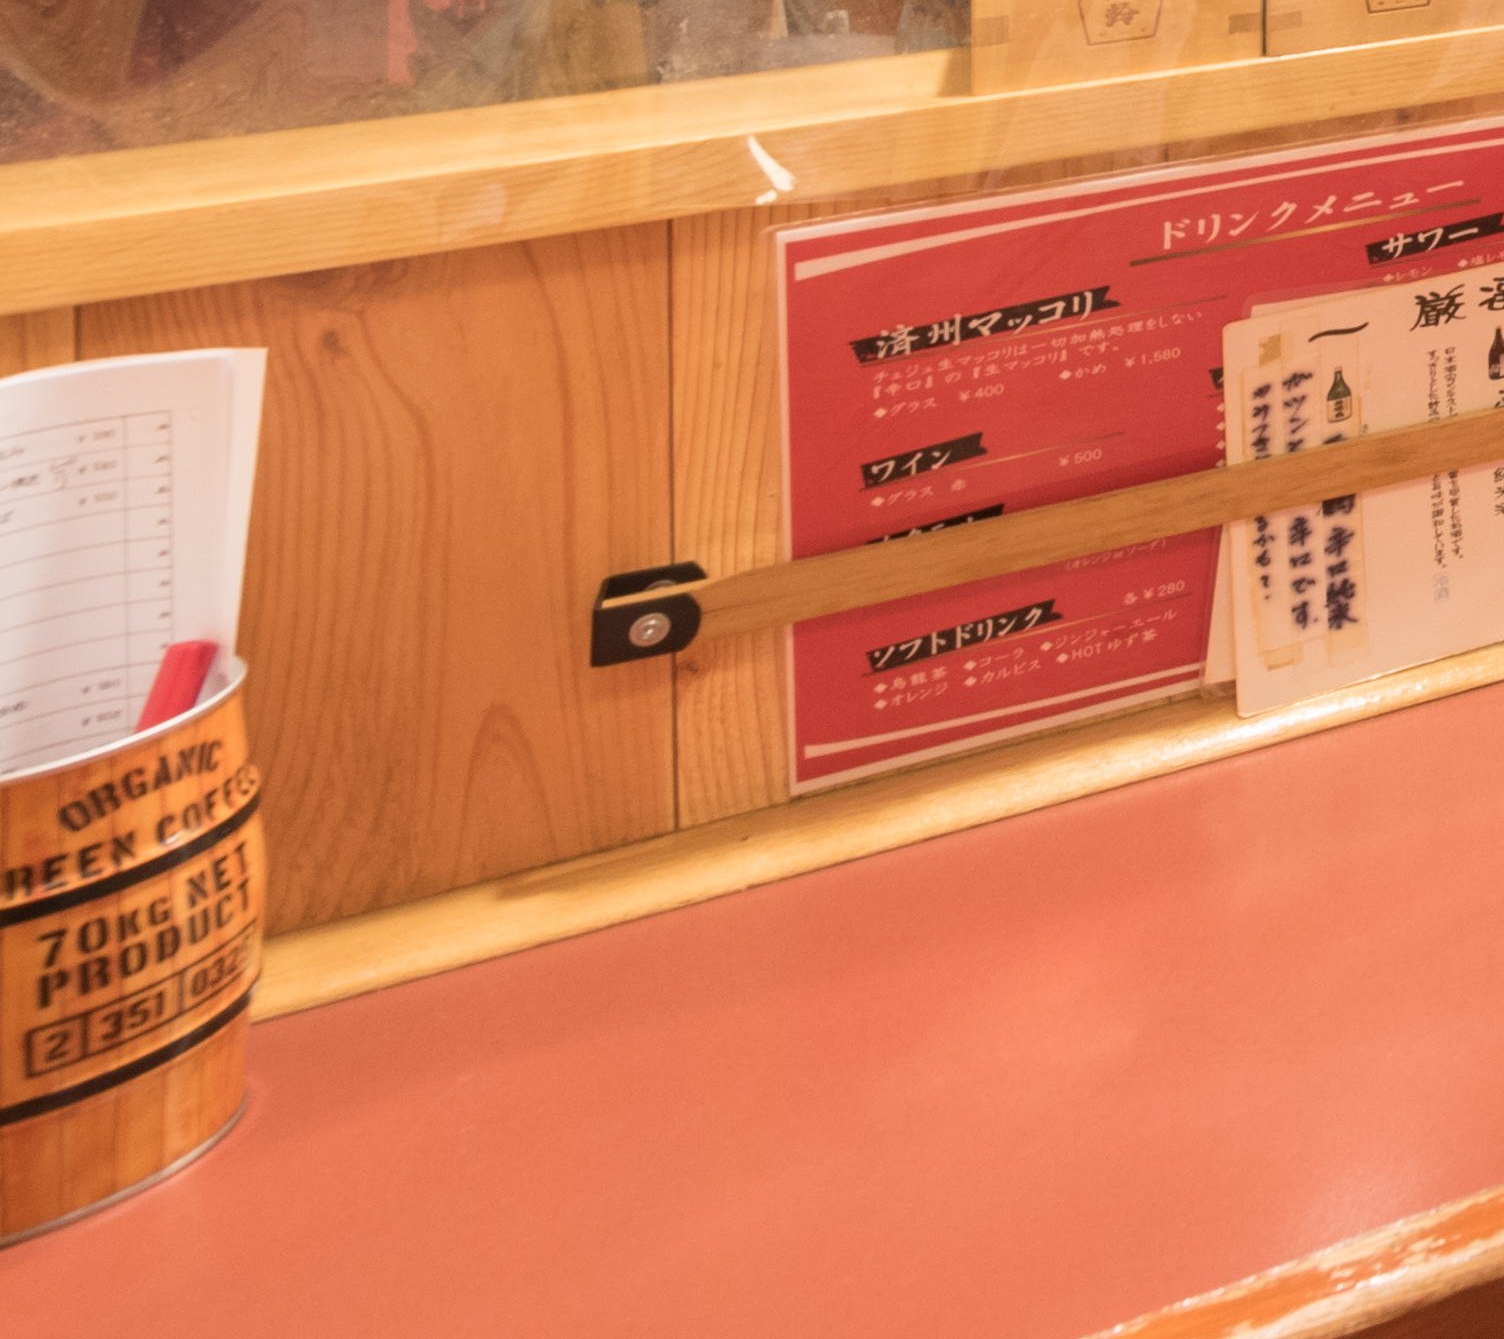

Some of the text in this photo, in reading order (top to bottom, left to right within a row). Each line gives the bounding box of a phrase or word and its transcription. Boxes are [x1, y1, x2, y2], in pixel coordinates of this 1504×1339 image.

[1161, 179, 1465, 250] ドリンクメニュー
[1382, 226, 1480, 259] サワー
[875, 290, 1097, 360] 済州マッコリ
[871, 448, 953, 483] ワイン
[1058, 448, 1103, 467] ¥500
[873, 606, 1044, 669] ソフトドリンク
[1053, 608, 1178, 650] ジンジャーエール
[978, 647, 1026, 669] コーラ
[980, 660, 1042, 686] カルピス
[889, 683, 949, 709] オレンジ
[58, 740, 223, 833] ORGANIC
[37, 842, 247, 969] 70KG NET
[38, 881, 250, 1010] PRODUCT
[100, 992, 165, 1043] 351
[46, 1031, 70, 1062] 2
